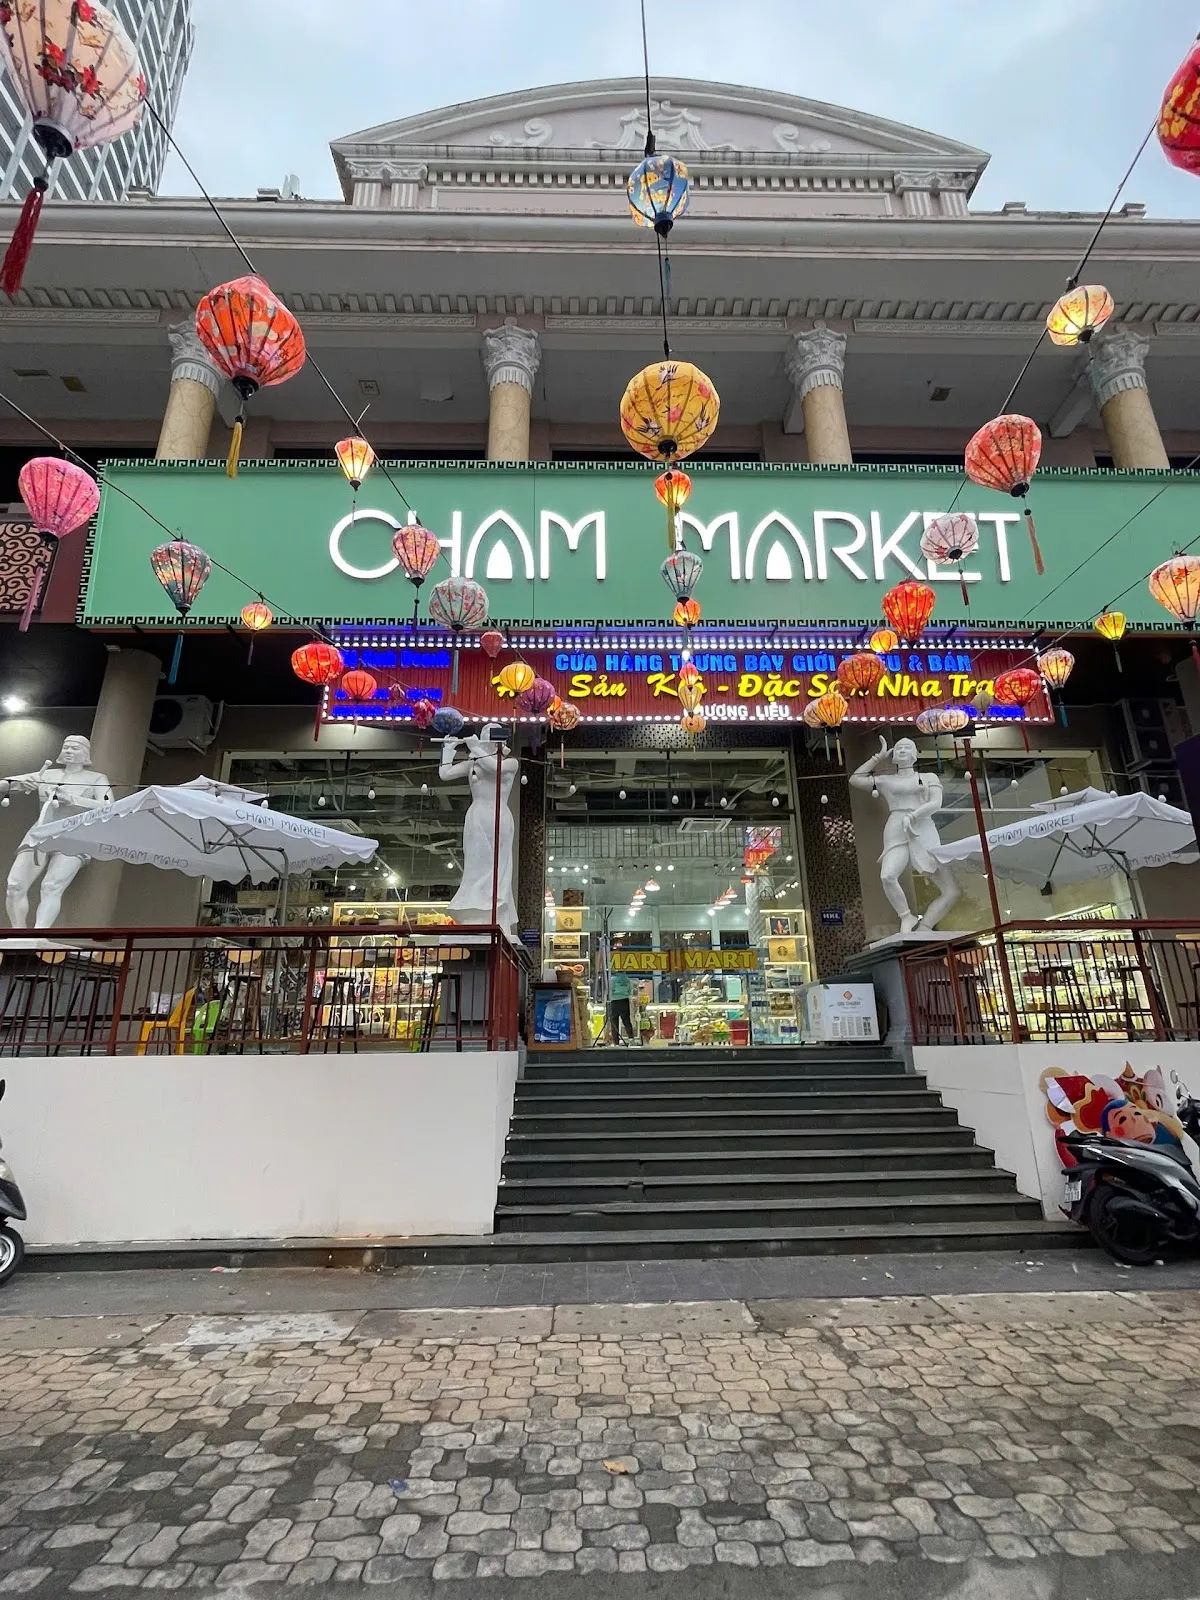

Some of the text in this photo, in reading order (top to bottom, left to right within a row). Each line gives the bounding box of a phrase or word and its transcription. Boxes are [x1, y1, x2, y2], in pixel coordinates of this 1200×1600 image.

[329, 509, 606, 580] CHAM
[606, 651, 662, 671] HÀNG
[744, 651, 784, 671] BÀY
[792, 650, 836, 671] GIỚI
[908, 654, 924, 671] &
[569, 673, 627, 697] Sản
[738, 673, 800, 702] Đặc
[877, 673, 942, 697] Nha
[948, 674, 996, 697] Tra
[235, 809, 326, 839] CHAM MARKET
[989, 814, 1075, 844] CHAM MARKET
[684, 951, 751, 969] MART
